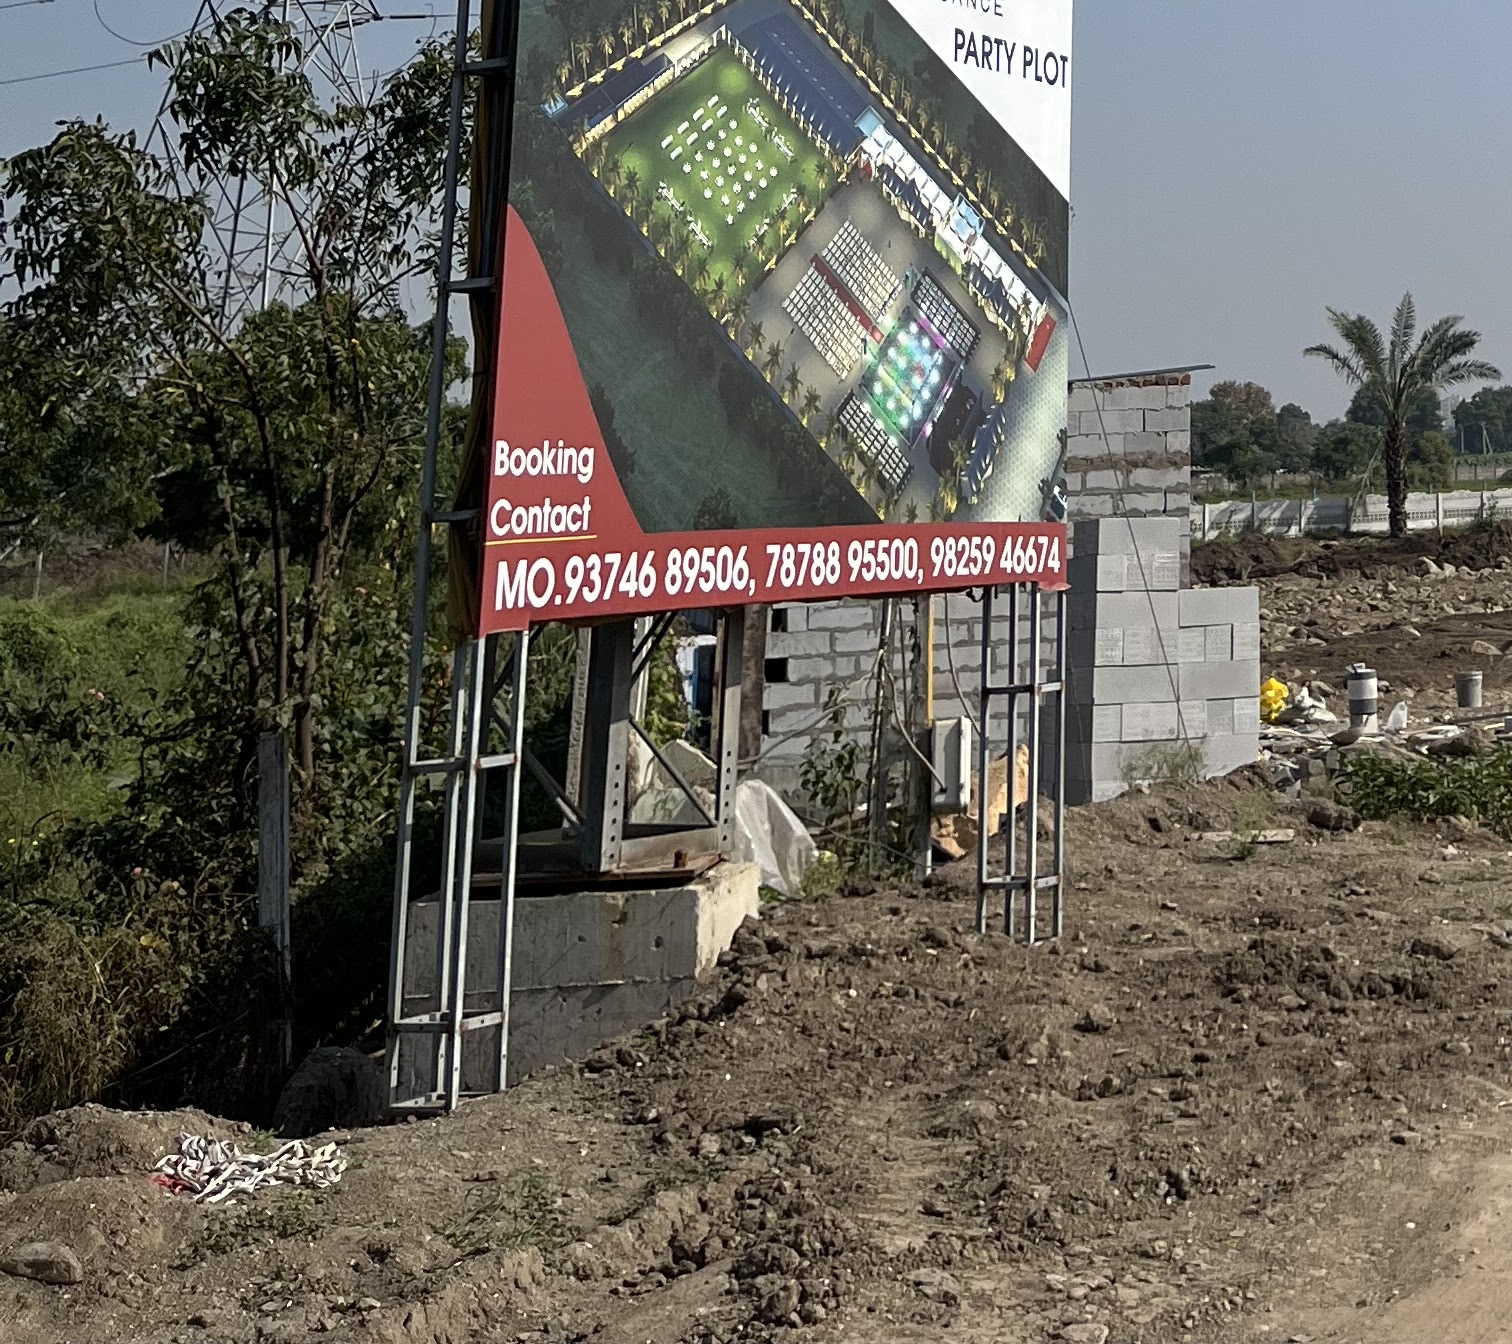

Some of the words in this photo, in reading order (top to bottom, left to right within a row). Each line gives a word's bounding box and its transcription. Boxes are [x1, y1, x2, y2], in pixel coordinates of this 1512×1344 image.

[954, 28, 1016, 76] PARTY
[1023, 45, 1068, 88] PLOT
[494, 440, 594, 484] Booking
[490, 496, 591, 536] Contact
[665, 545, 756, 598] 89506,
[765, 541, 839, 588] 78788
[849, 537, 923, 584] 95500,
[930, 535, 995, 578] 98259
[1000, 532, 1061, 573] 46674
